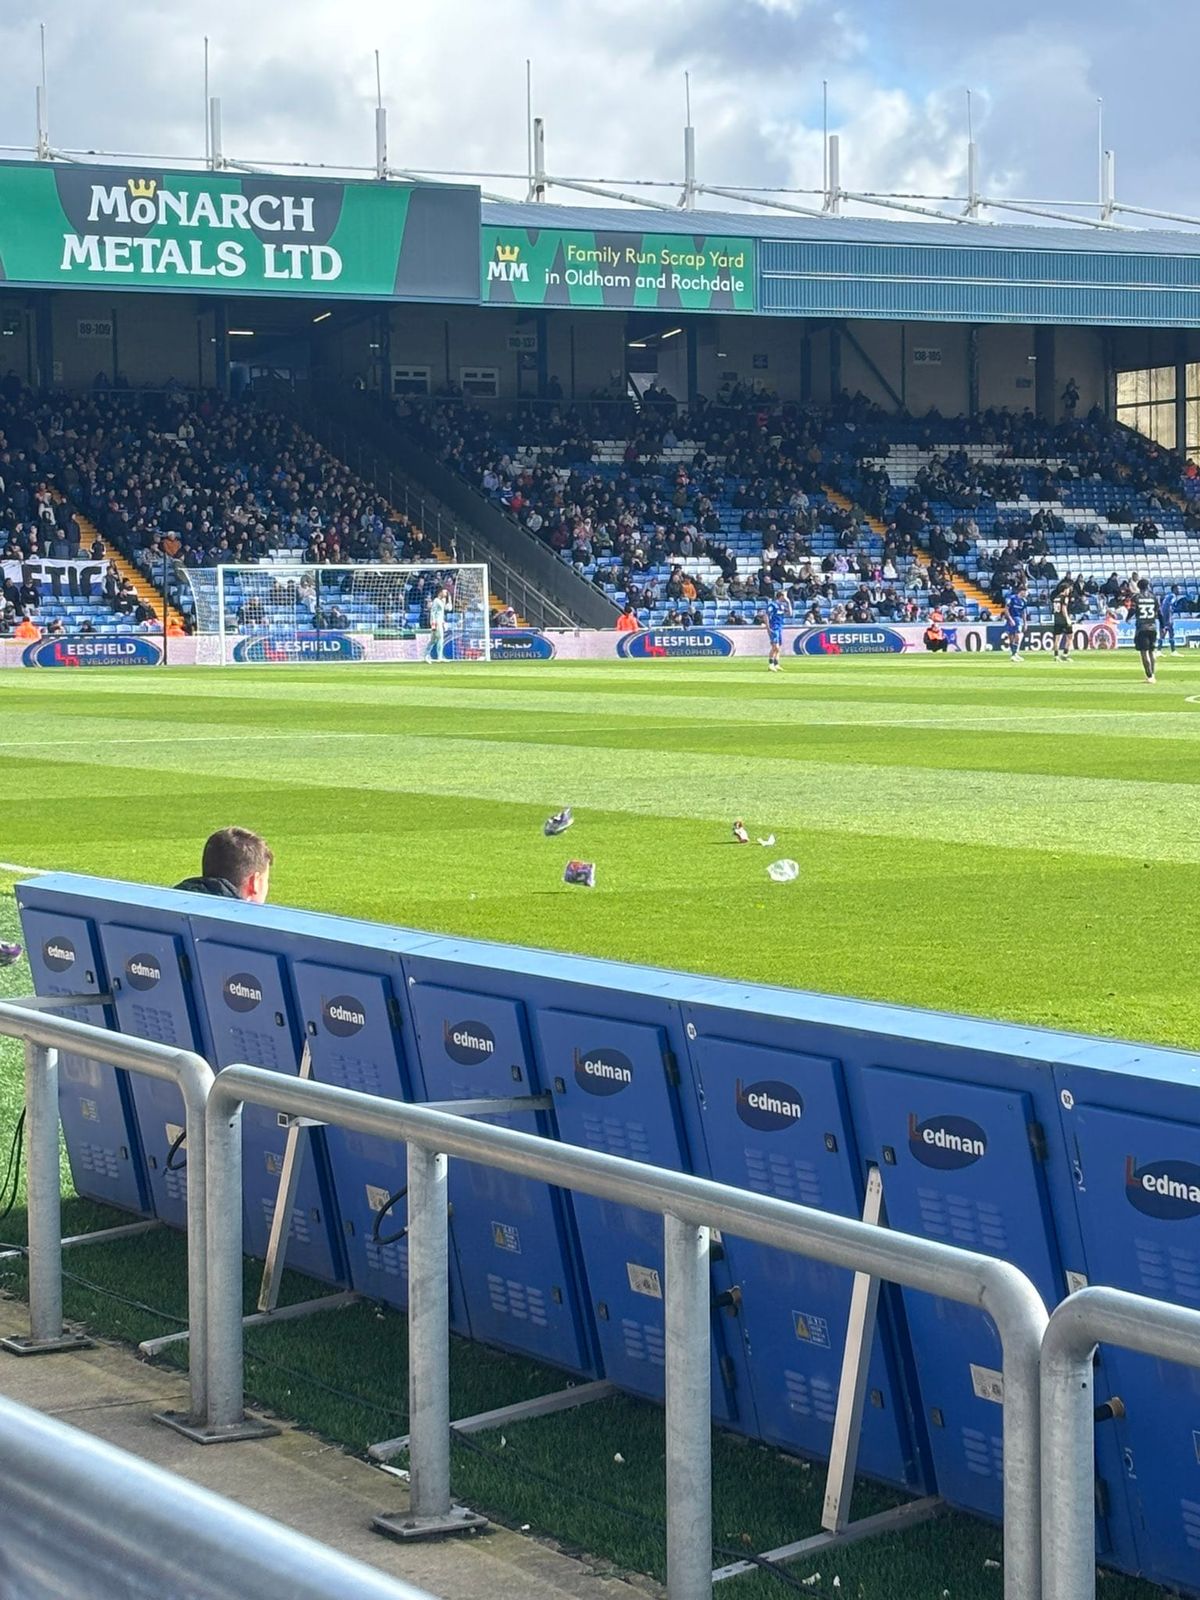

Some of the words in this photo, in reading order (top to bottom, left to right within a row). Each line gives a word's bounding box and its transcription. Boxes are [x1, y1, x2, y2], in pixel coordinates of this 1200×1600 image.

[60, 233, 247, 277] METALS
[262, 243, 343, 281] LTD
[567, 245, 621, 267] Family
[626, 248, 657, 265] Run
[660, 249, 706, 271] Scrap
[709, 251, 745, 269] Yard
[487, 261, 530, 283] MM
[545, 268, 560, 285] in
[565, 269, 631, 289] Oldham
[635, 273, 666, 290] and
[671, 275, 745, 292] Rochdale
[1138, 604, 1155, 619] 33
[965, 631, 982, 652] 0
[1073, 629, 1089, 650] 0
